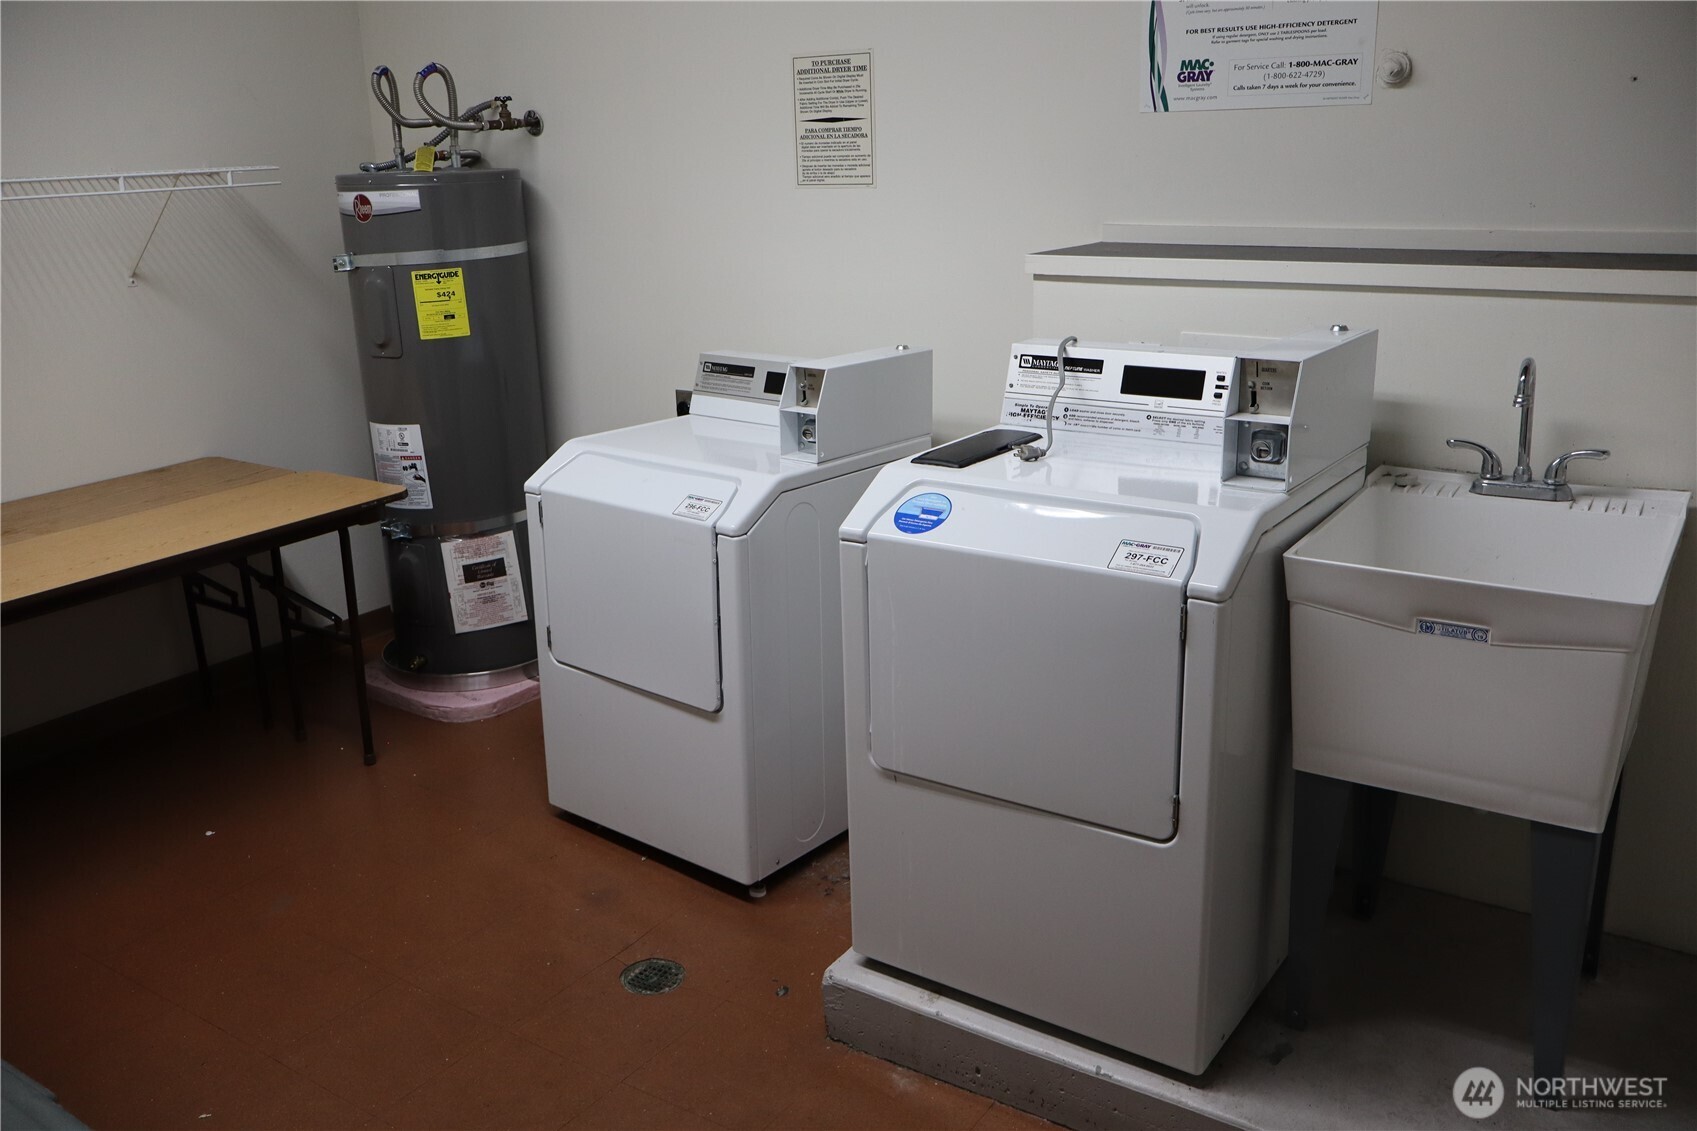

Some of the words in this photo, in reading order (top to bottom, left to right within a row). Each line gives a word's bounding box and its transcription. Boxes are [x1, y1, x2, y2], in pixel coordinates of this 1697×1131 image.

[1259, 21, 1316, 30] HIGH-EFFICIENCY
[1289, 57, 1358, 68] 1-800-MAC-GRAY
[1177, 70, 1214, 83] GRAY
[1263, 70, 1325, 82] (1-800-622-4729)
[415, 271, 459, 281] ENERGYGUIDE
[1125, 552, 1169, 565] 297-FCC
